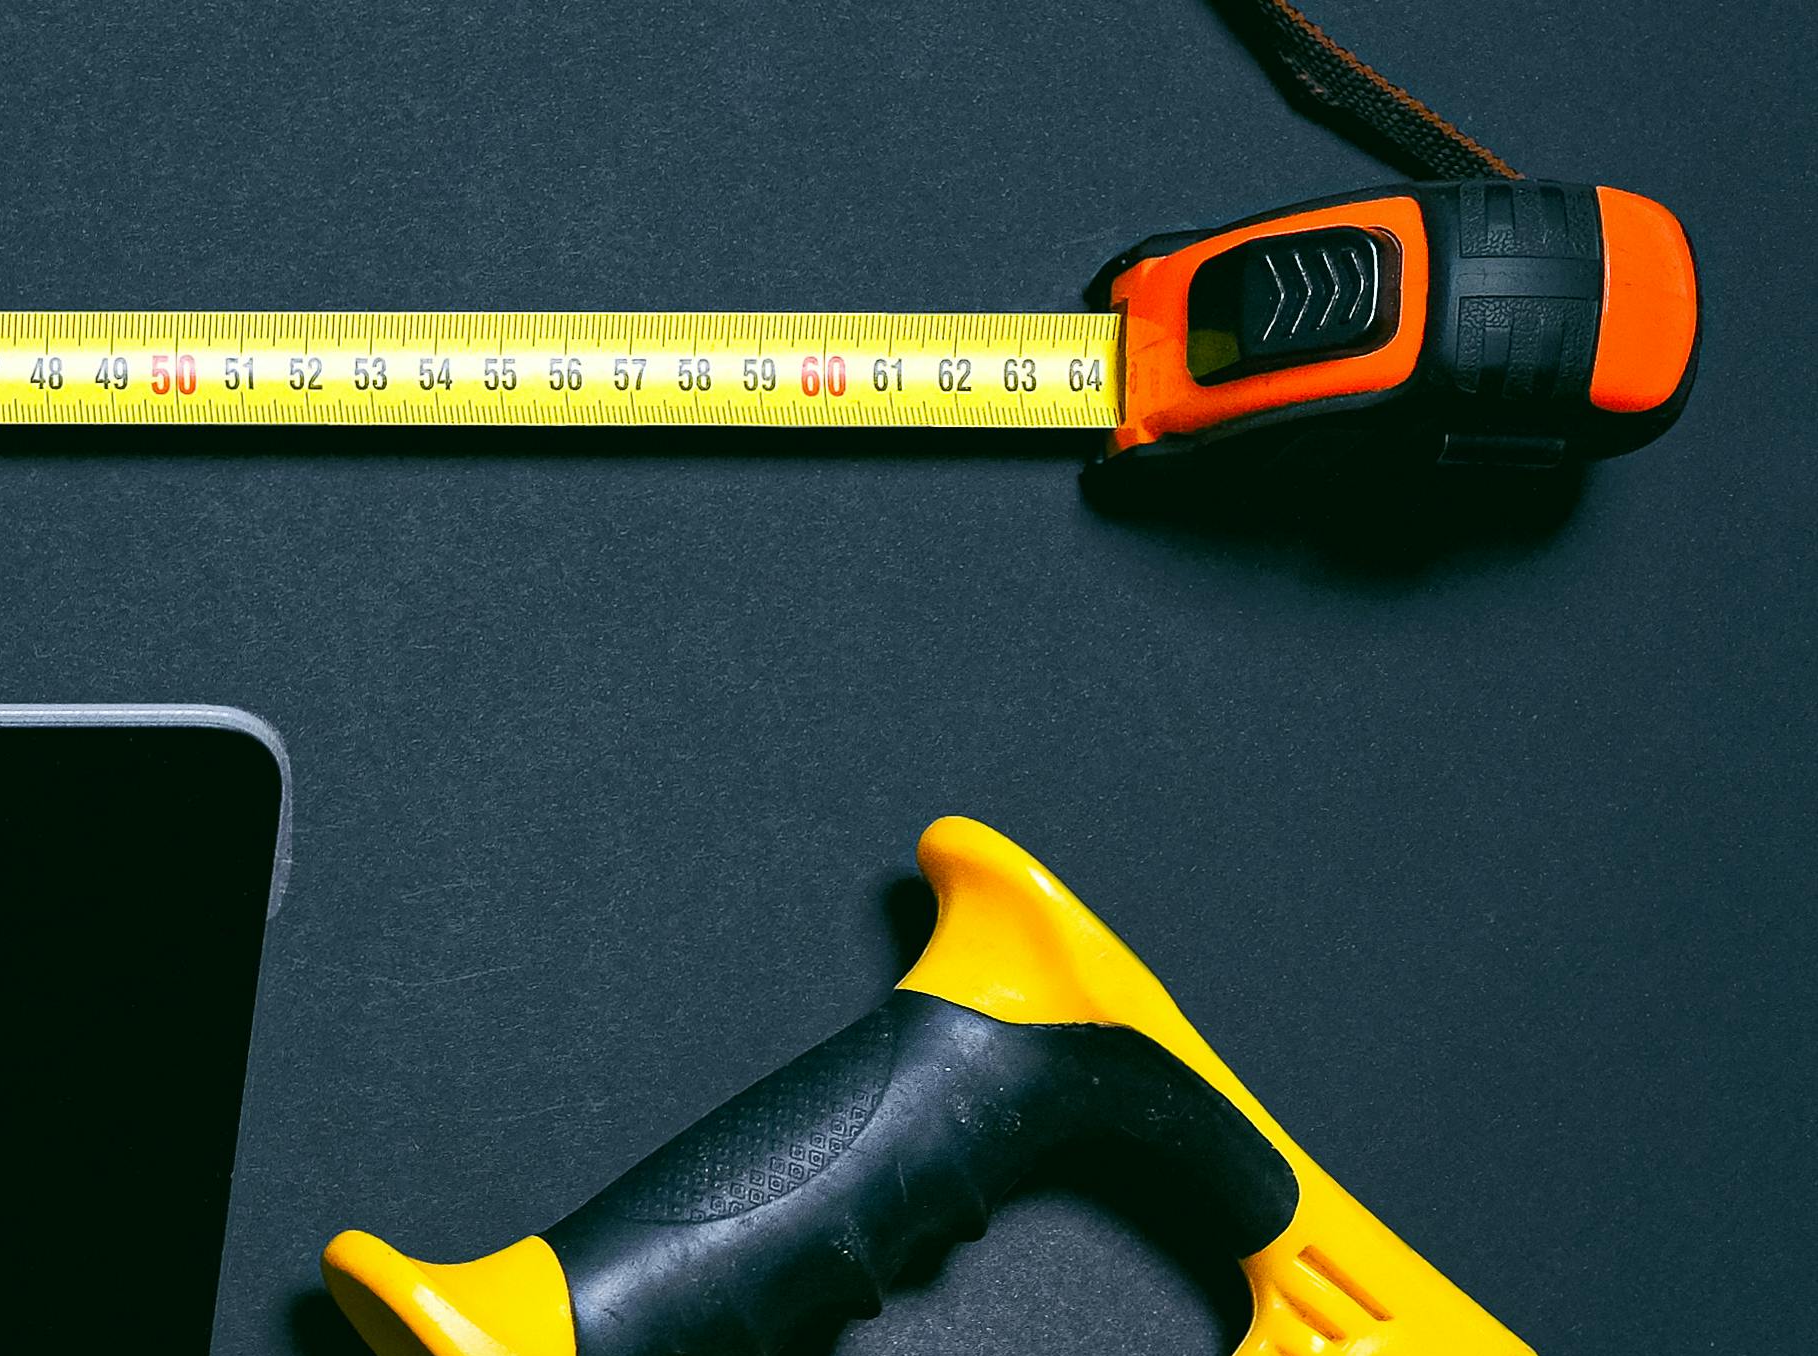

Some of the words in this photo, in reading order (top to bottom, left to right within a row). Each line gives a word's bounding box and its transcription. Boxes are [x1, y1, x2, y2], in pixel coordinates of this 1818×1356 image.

[95, 357, 128, 390] 49
[151, 355, 196, 395] 50
[225, 357, 254, 390] 51
[290, 358, 323, 390] 52
[484, 359, 517, 391] 55
[614, 359, 646, 391] 57
[743, 359, 776, 391] 59
[801, 356, 846, 397] 60
[873, 358, 902, 392] 61
[1004, 359, 1036, 392] 63
[1069, 359, 1102, 392] 64
